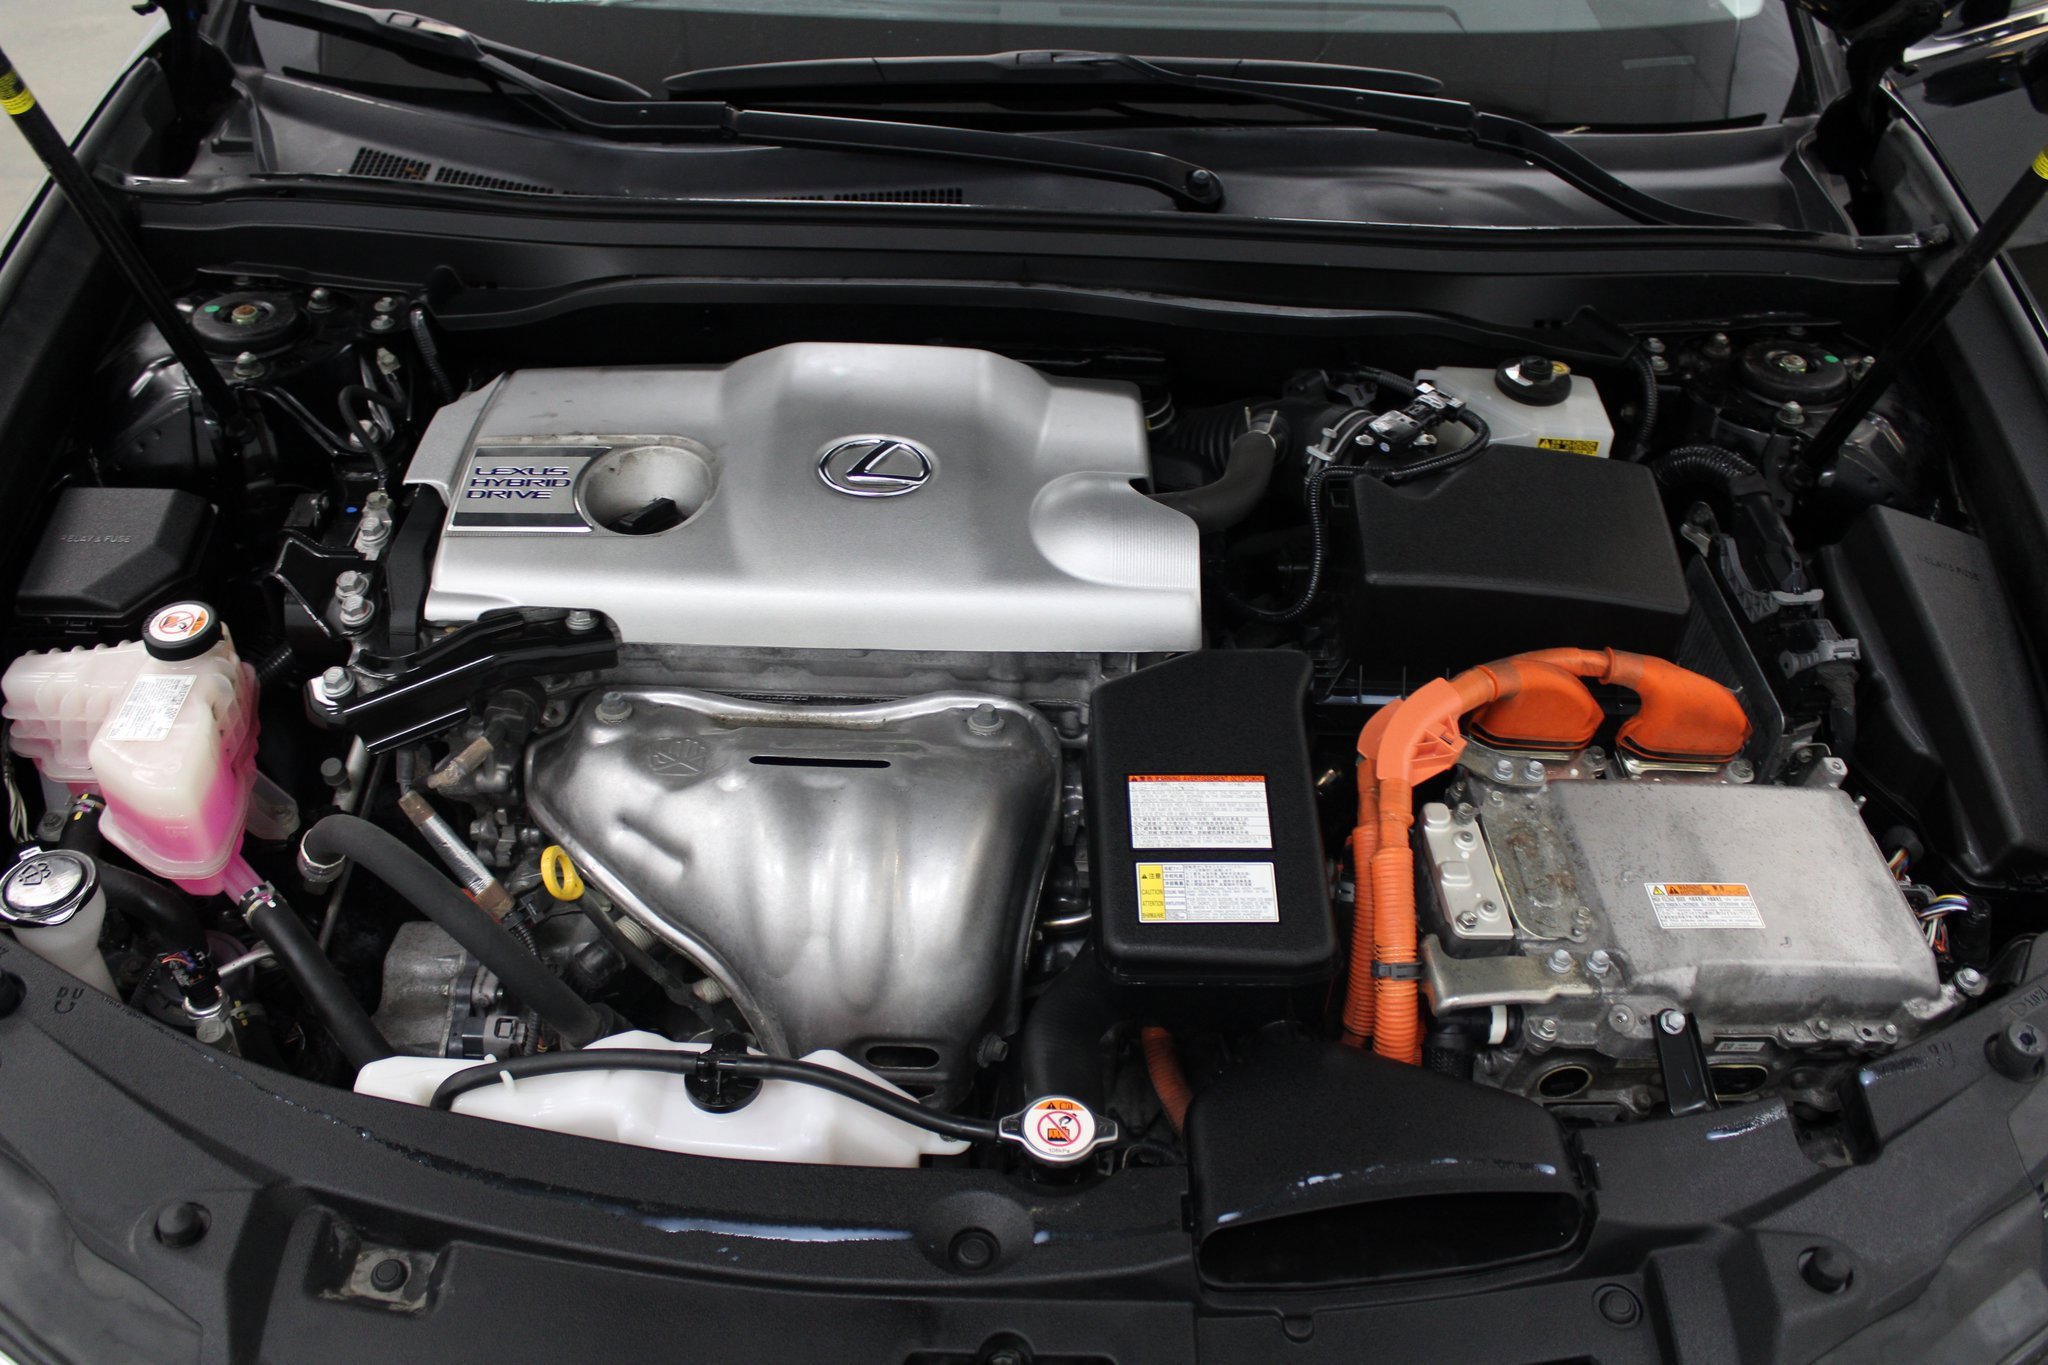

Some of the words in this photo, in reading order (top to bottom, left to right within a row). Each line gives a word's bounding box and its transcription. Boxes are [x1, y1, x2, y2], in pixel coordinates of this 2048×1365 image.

[475, 467, 569, 476] LEXUS
[470, 478, 571, 488] HYBRID
[466, 489, 553, 499] DRIVE
[103, 534, 132, 543] FUSE
